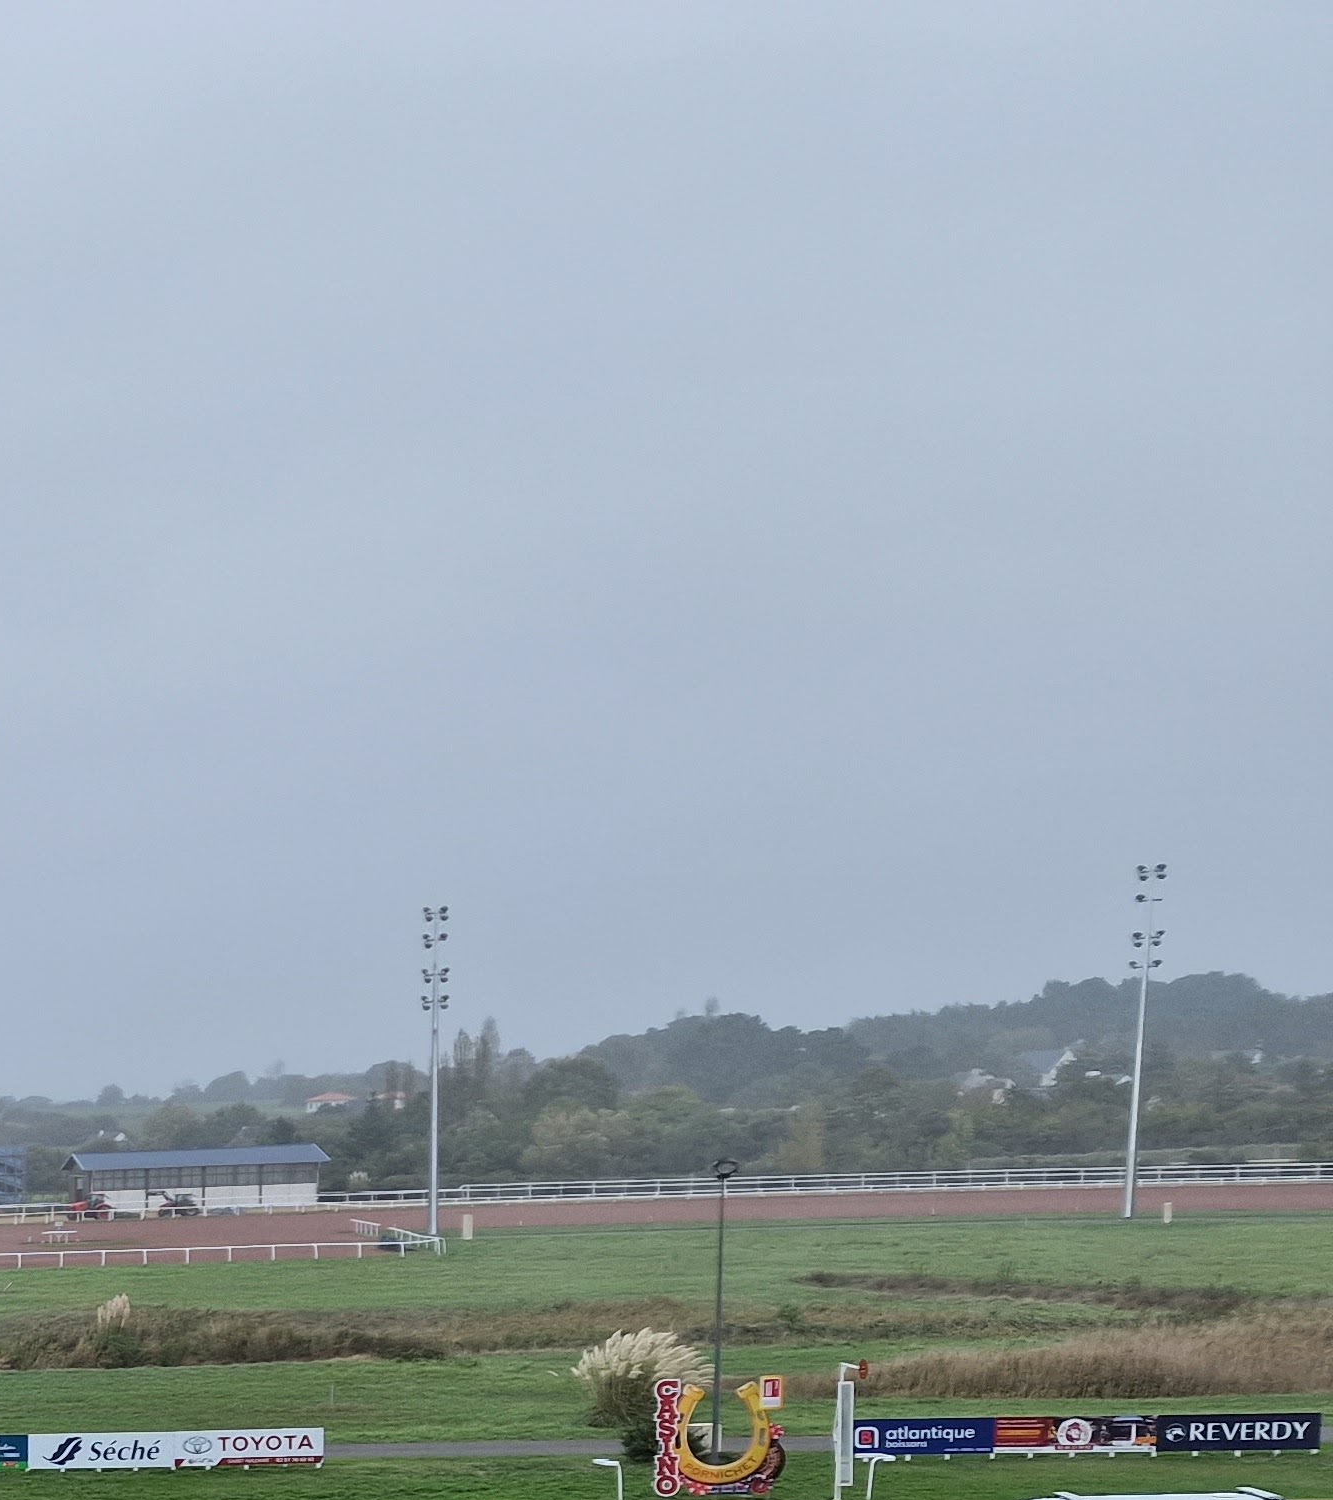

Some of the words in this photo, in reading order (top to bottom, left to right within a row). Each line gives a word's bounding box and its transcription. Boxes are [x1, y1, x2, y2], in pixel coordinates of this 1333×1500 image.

[654, 1379, 681, 1497] CASINO
[885, 1425, 976, 1442] atlantique
[1188, 1421, 1311, 1441] REVERDY
[88, 1440, 161, 1461] Séché
[217, 1435, 314, 1451] TOYOTA
[683, 1456, 757, 1479] PORNICHET
